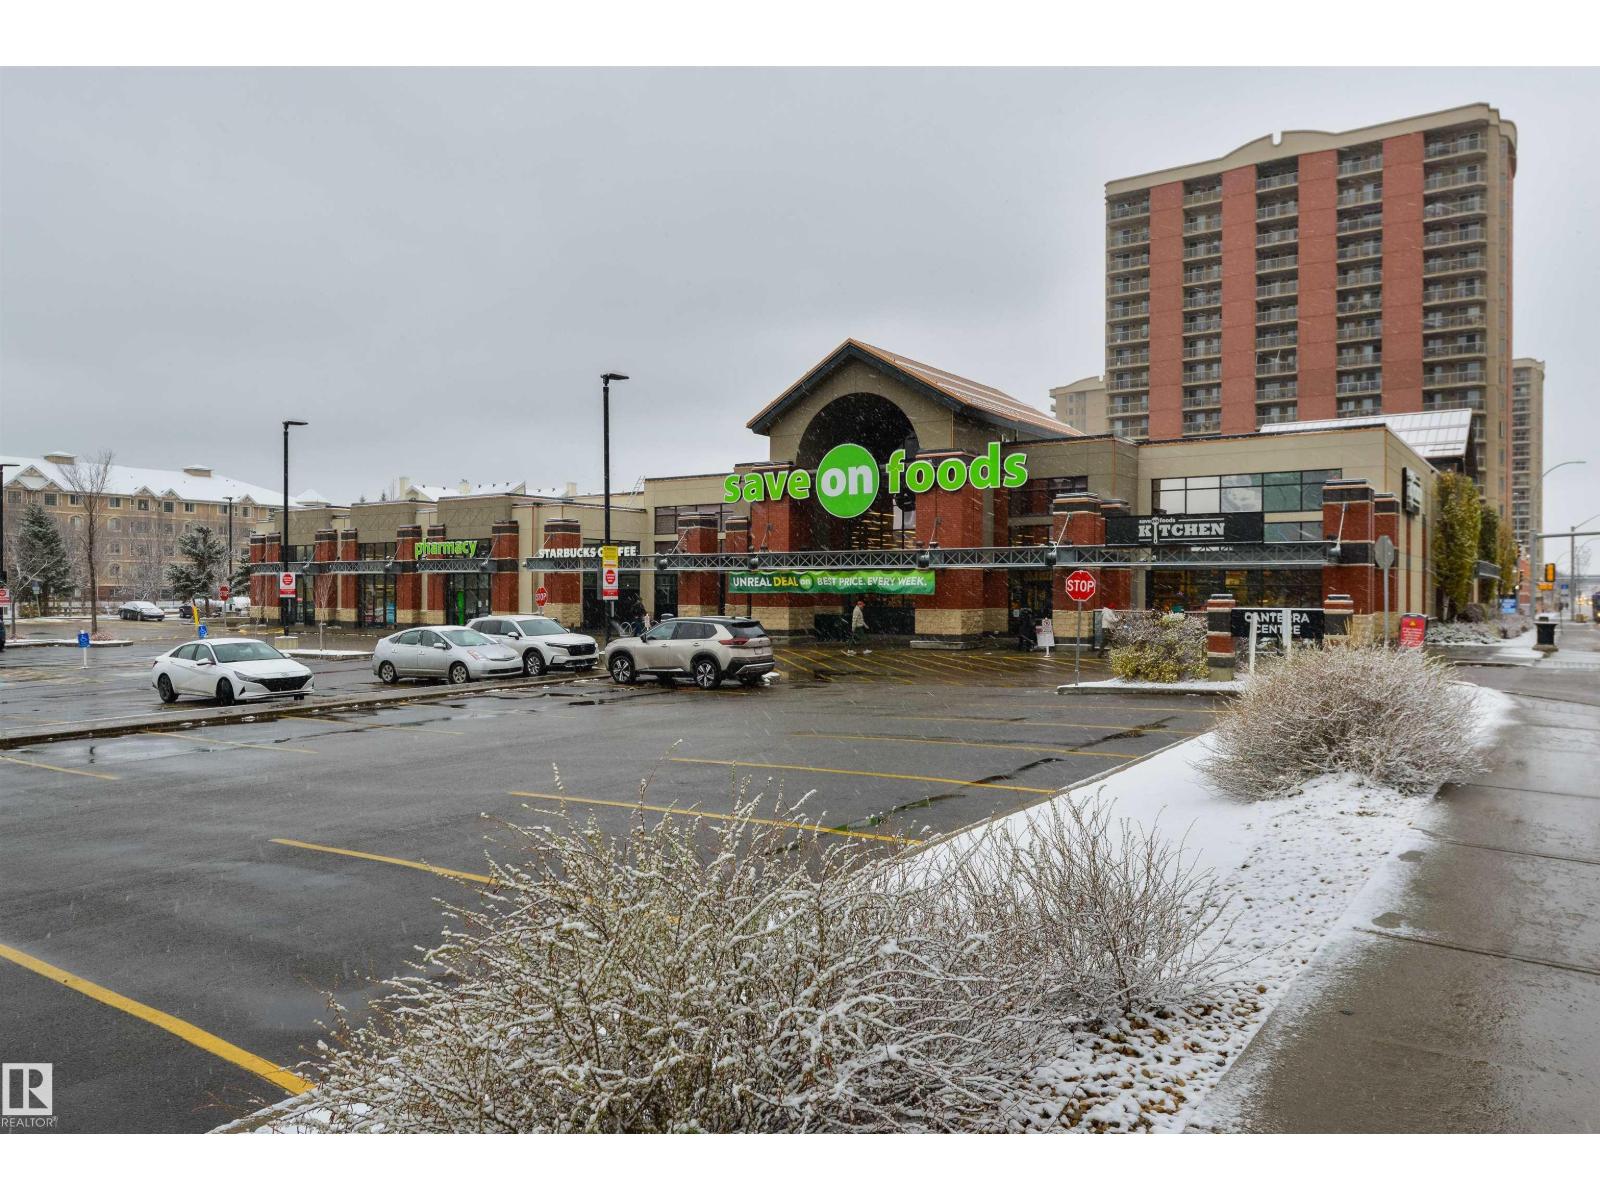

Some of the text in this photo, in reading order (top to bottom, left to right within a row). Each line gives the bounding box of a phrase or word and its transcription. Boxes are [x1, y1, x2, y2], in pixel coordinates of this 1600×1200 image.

[722, 441, 1029, 504] save on foods
[415, 539, 478, 560] pharmacy
[538, 547, 596, 559] STARBUCKS
[598, 545, 637, 557] CFEE
[733, 577, 772, 587] UNREAL
[773, 577, 799, 587] DEAL
[817, 576, 837, 586] BEST
[839, 576, 866, 586] PRICE.
[867, 576, 895, 586] EVERY
[897, 576, 928, 587] WEEK.
[1067, 579, 1095, 592] STOP
[1244, 612, 1310, 623] CANTERA
[1255, 624, 1301, 635] CENTE
